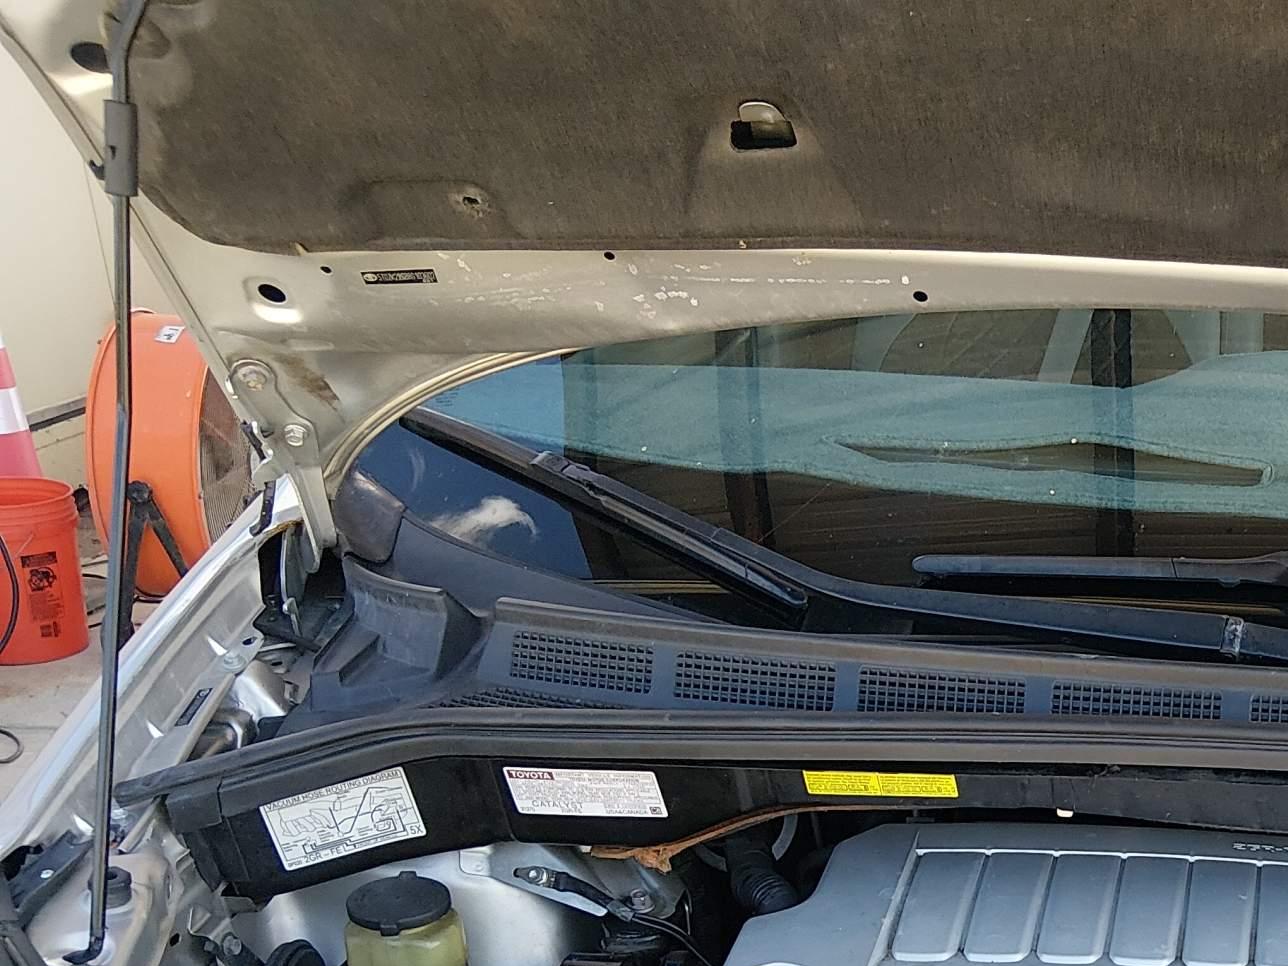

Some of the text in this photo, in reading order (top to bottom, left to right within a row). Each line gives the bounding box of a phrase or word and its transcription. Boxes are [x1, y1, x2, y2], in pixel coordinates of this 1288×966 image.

[509, 770, 552, 779] TOYOTA
[266, 769, 401, 811] VACUUM HOSE ROUTING DIAGRAM
[531, 799, 584, 809] CATALYST
[410, 824, 424, 835] 5X
